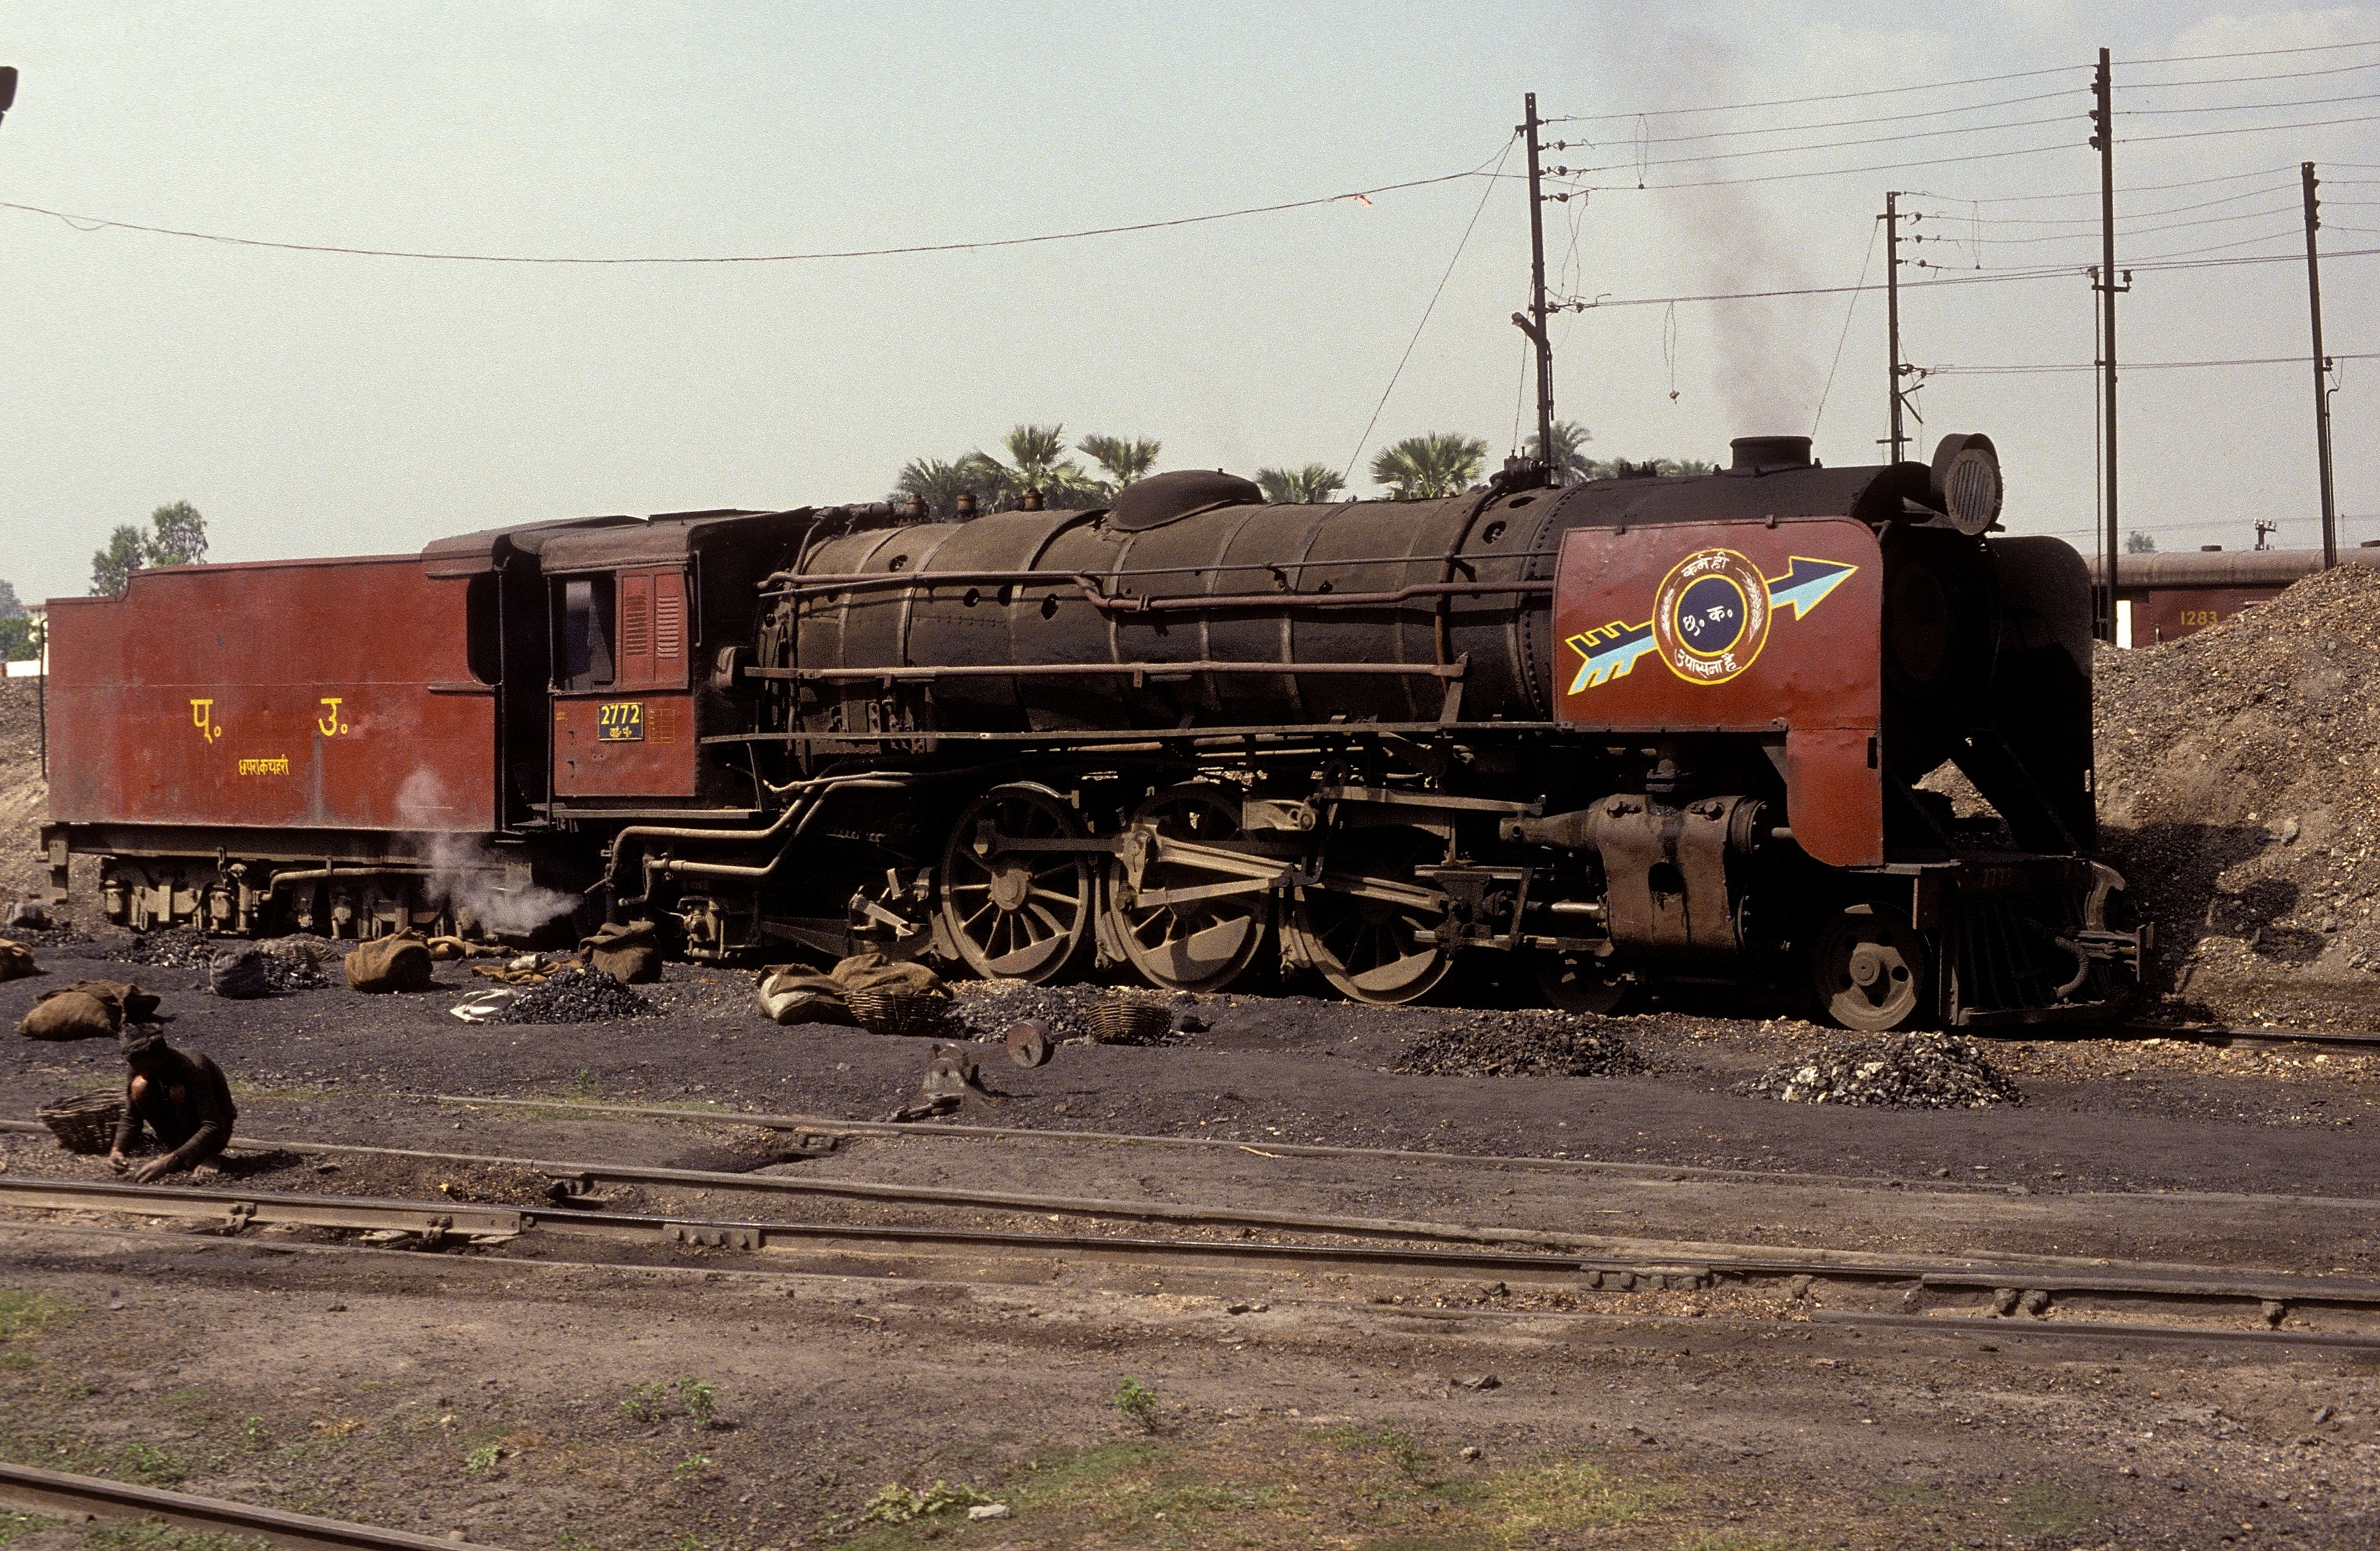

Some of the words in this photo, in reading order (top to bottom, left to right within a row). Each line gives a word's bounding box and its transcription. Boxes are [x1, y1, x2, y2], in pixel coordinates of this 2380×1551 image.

[1711, 551, 1730, 573] ही
[2181, 610, 2218, 626] 1283
[1721, 652, 1742, 672] है
[601, 704, 639, 725] 2772
